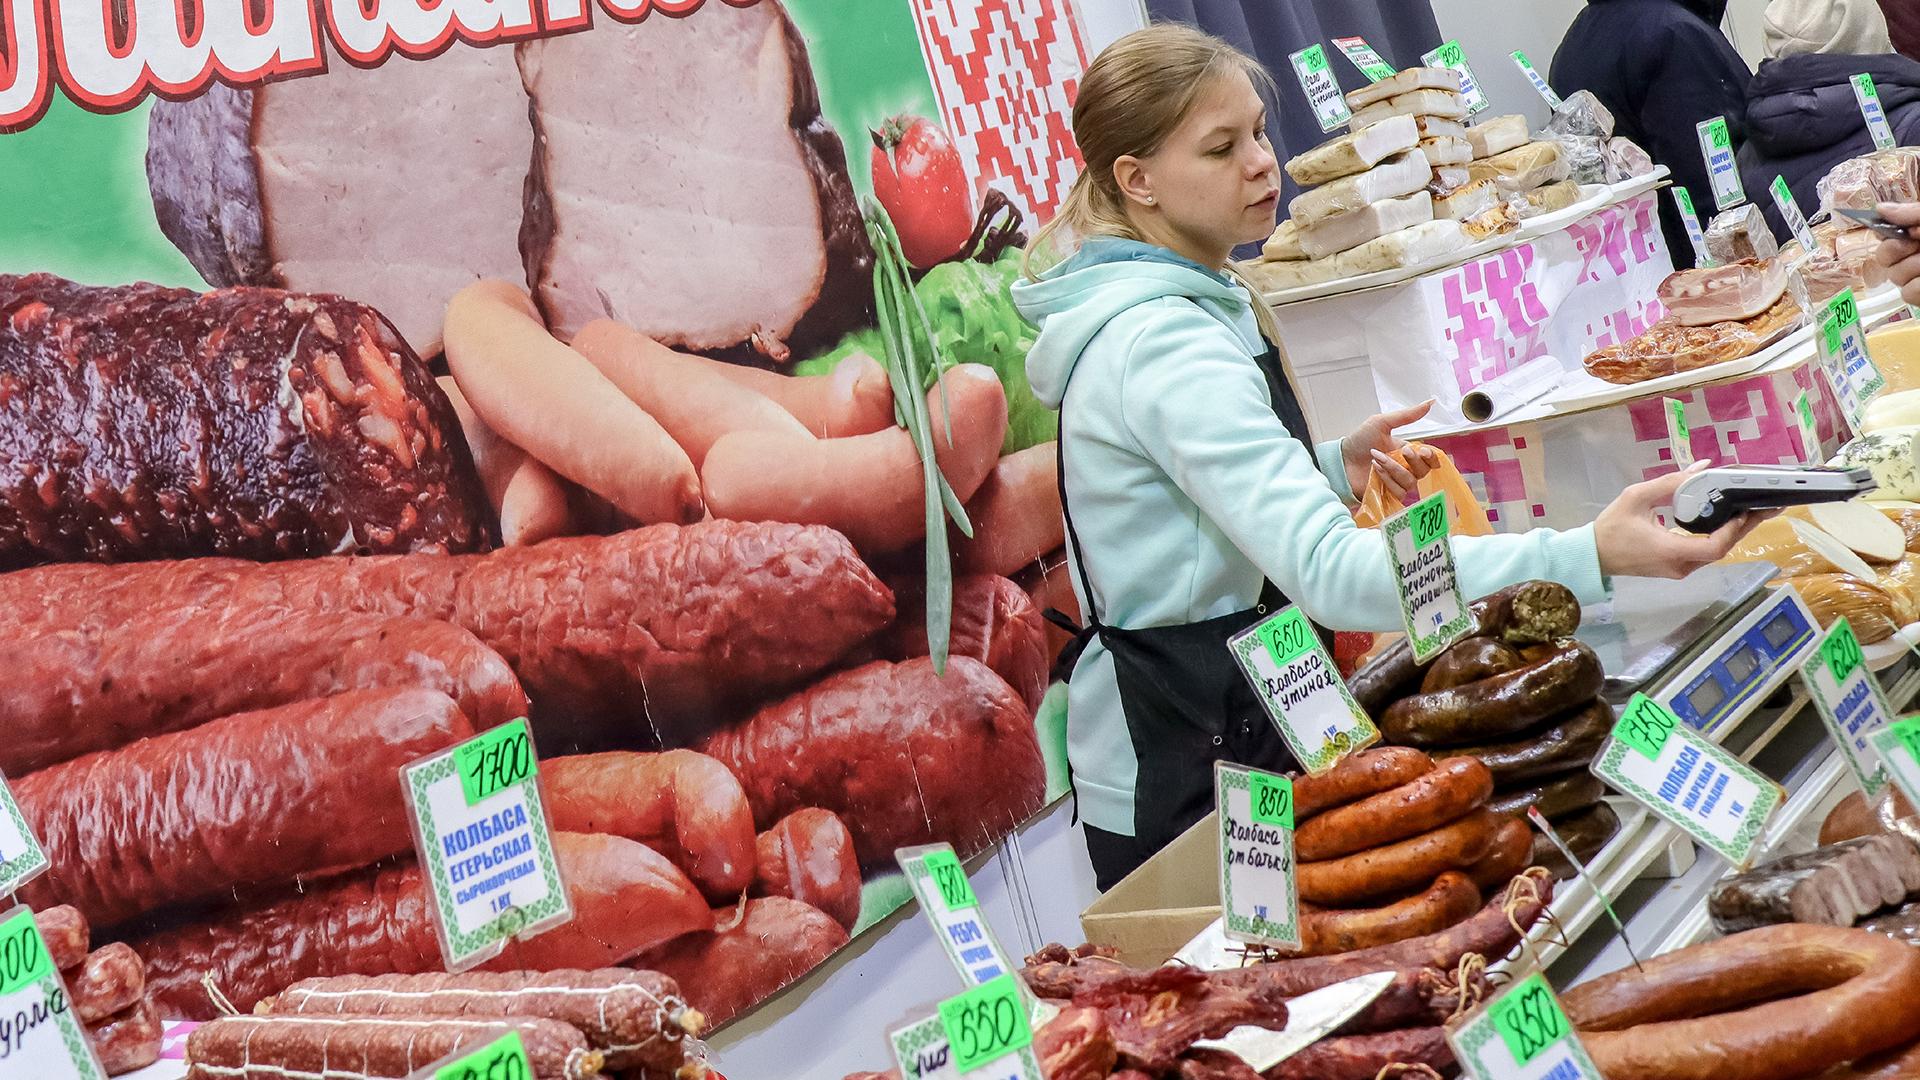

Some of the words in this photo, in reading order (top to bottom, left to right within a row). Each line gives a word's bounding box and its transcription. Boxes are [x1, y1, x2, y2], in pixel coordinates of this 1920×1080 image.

[1836, 298, 1852, 328] 850
[1418, 503, 1444, 542] 580
[1262, 621, 1276, 633] ЦЕНА
[1272, 619, 1304, 660] 650
[1264, 654, 1322, 699] Колбаса
[1832, 629, 1859, 681] 620
[1280, 670, 1337, 712] утиная
[1833, 680, 1871, 725] КОЛБАСА
[462, 738, 485, 756] ЦЕНА
[1323, 729, 1330, 740] 1
[1630, 699, 1676, 752] 750
[470, 732, 530, 796] 1700
[1656, 745, 1702, 804] КОЛБАСА
[1682, 761, 1718, 811] ЖАРЕНАЯ
[1258, 786, 1288, 818] 850
[1698, 772, 1730, 820] ГОВЯДИНА
[1728, 810, 1736, 819] 1
[442, 804, 528, 857] КОЛБАСА
[450, 833, 532, 884] ЕГЕРЬСКАЯ
[1228, 848, 1245, 866] от
[456, 859, 536, 905] СЫРОКОПЧЕНАЯ
[490, 899, 497, 914] 1
[947, 919, 984, 946] РЕБРО
[960, 996, 1016, 1060] 550
[1506, 986, 1559, 1060] 850
